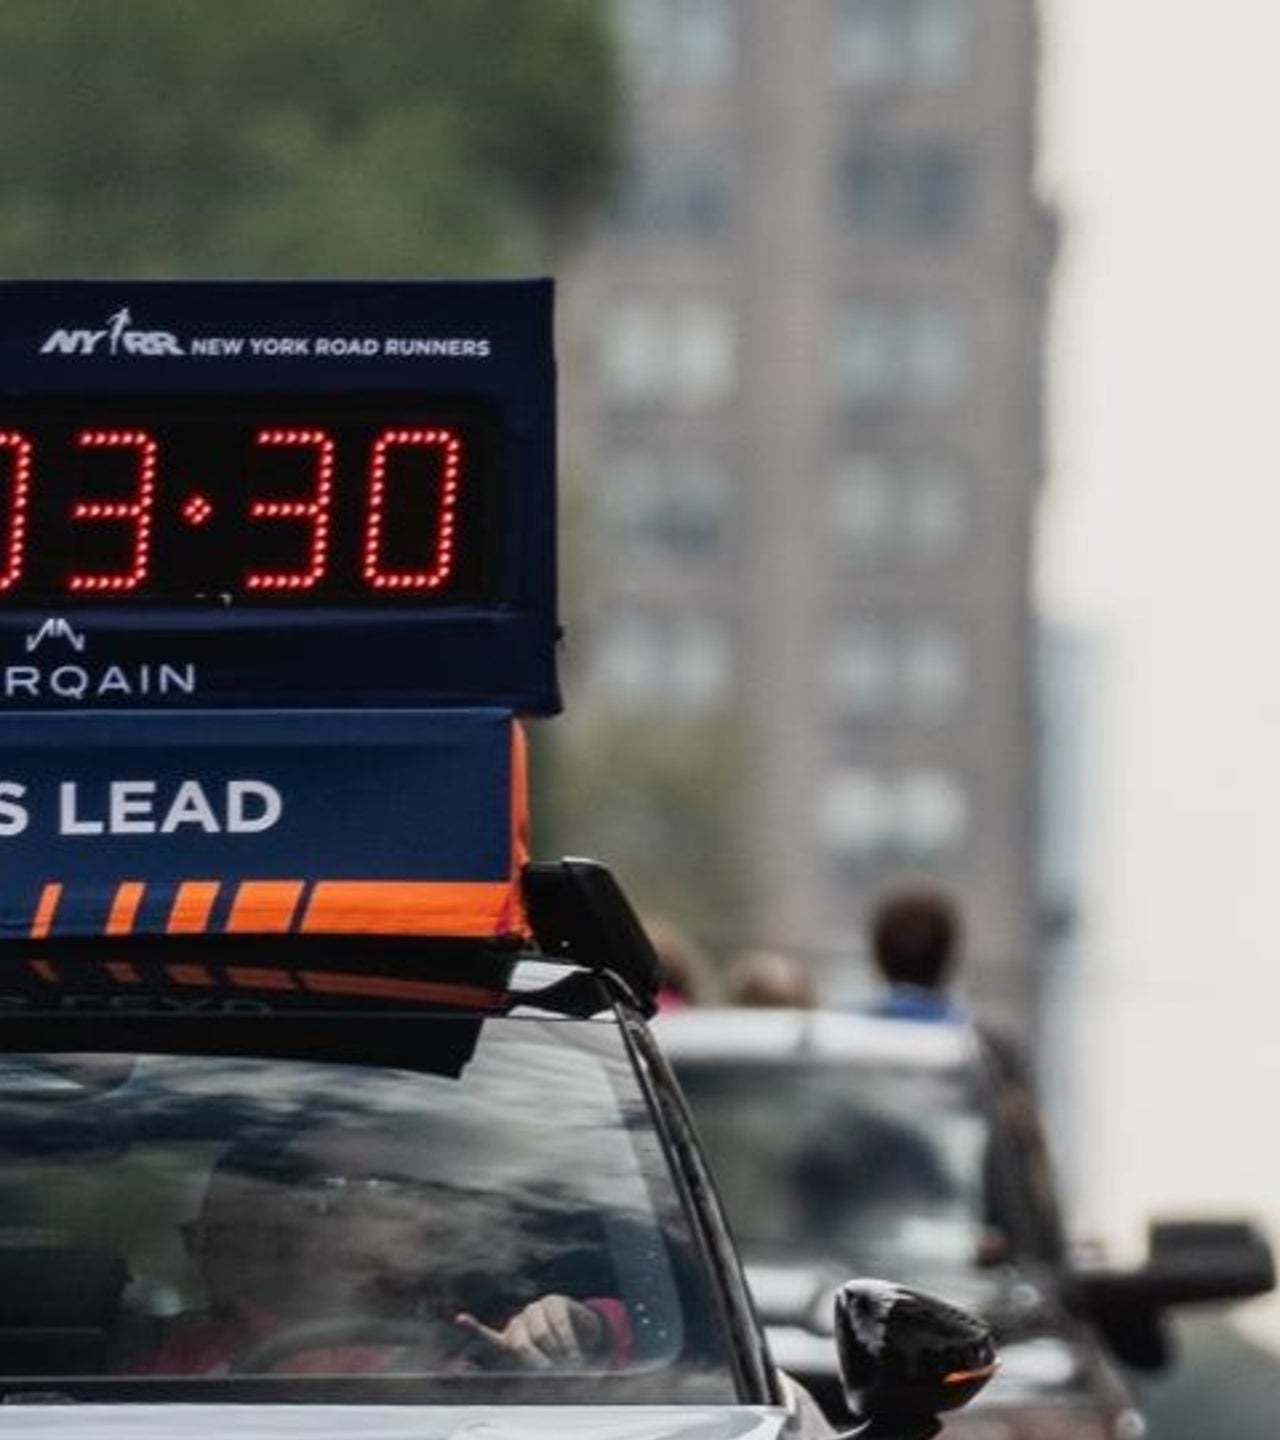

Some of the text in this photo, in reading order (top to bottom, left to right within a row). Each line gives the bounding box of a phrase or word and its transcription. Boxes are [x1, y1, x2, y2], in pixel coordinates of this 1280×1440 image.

[191, 337, 245, 356] NEW
[249, 337, 310, 356] YORK
[314, 337, 380, 356] ROAD
[384, 338, 491, 357] RUNNERS
[59, 780, 283, 836] LEAD
